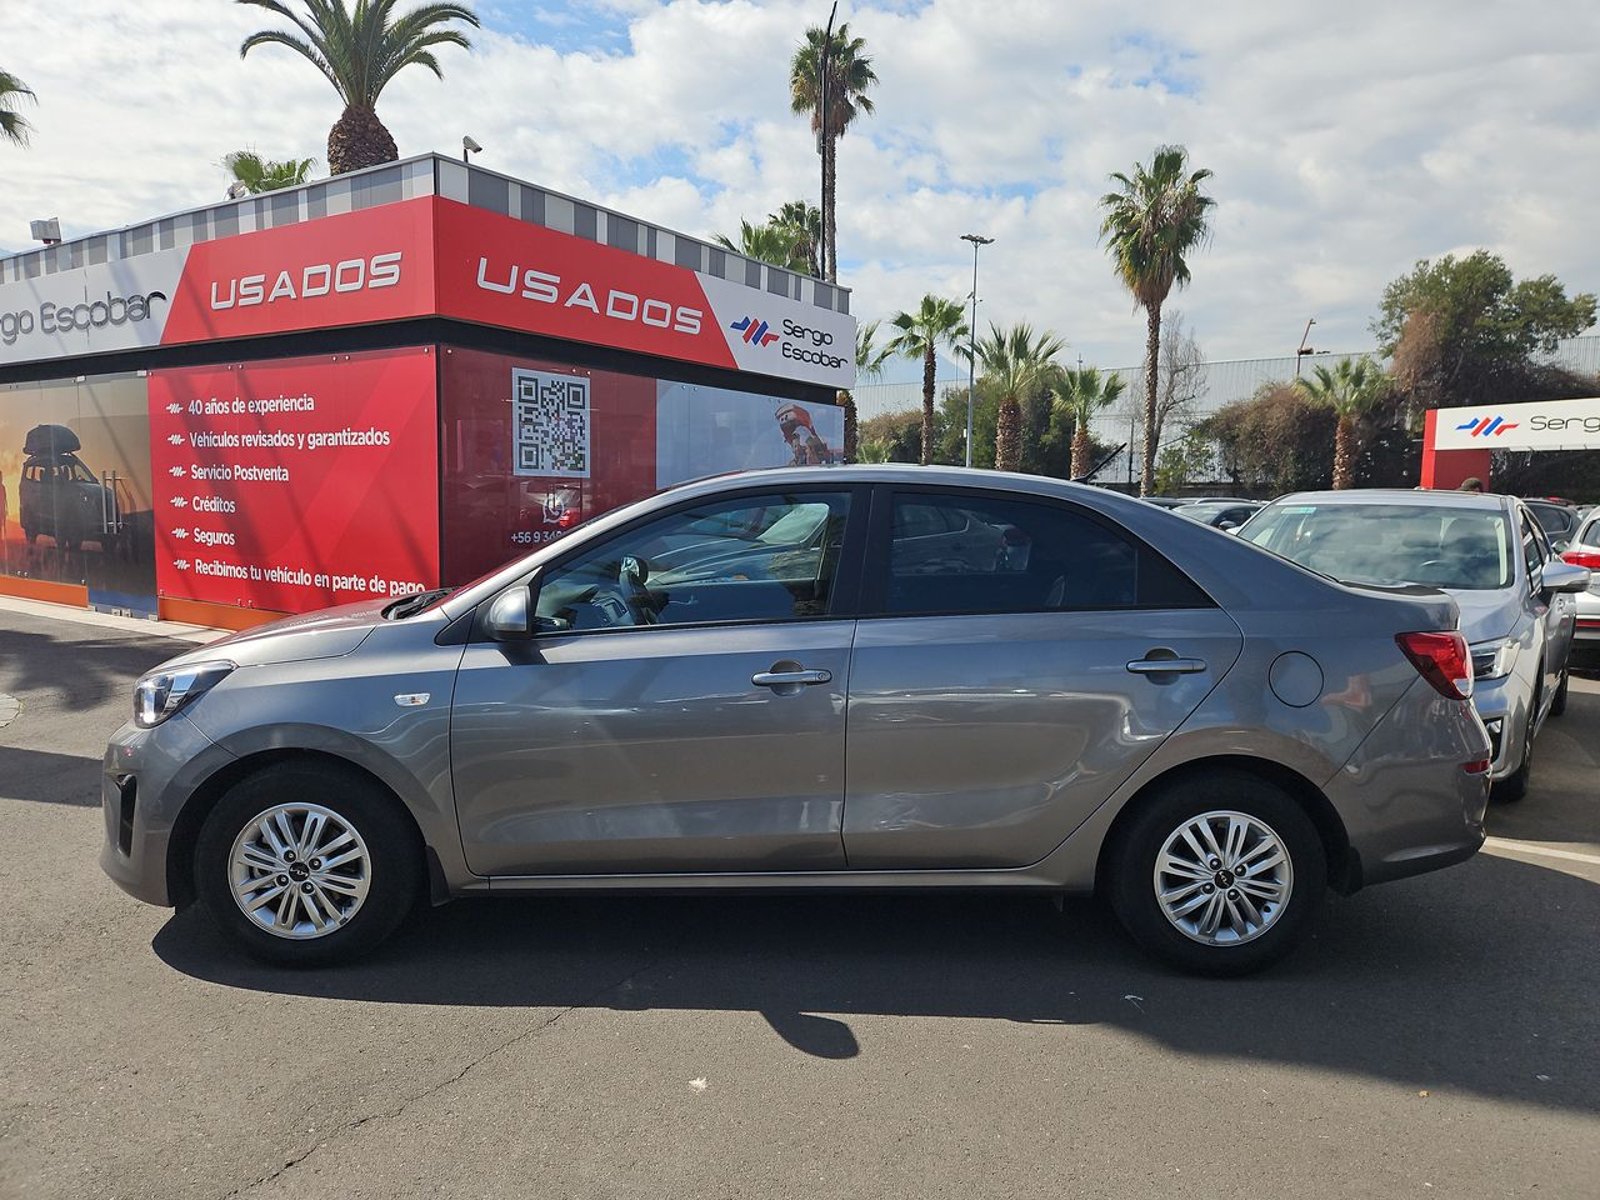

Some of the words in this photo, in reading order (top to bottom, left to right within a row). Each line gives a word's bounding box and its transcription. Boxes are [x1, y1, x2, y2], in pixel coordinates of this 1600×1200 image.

[210, 252, 402, 311] USADOS
[476, 257, 703, 335] USADOS
[40, 291, 167, 333] Escobar
[782, 342, 848, 369] Escobar
[188, 400, 202, 415] 40
[205, 398, 229, 414] años
[232, 396, 245, 413] de
[248, 394, 314, 414] experiencia
[1530, 415, 1600, 433] Serg
[190, 431, 239, 447] Vehículos
[242, 430, 294, 447] revisados
[298, 434, 304, 449] y
[308, 428, 390, 449] garantizados
[191, 465, 231, 480] Servicio
[234, 464, 289, 481] Postventa
[192, 496, 235, 512] Créditos
[194, 528, 235, 546] Seguros
[511, 531, 531, 543] +56
[533, 531, 541, 543] 9
[195, 559, 248, 579] Recibimos
[250, 565, 261, 580] tu
[264, 566, 311, 585] vehículo
[315, 574, 329, 587] en
[332, 575, 365, 593] parte
[369, 575, 386, 593] de
[390, 580, 425, 596] pago
